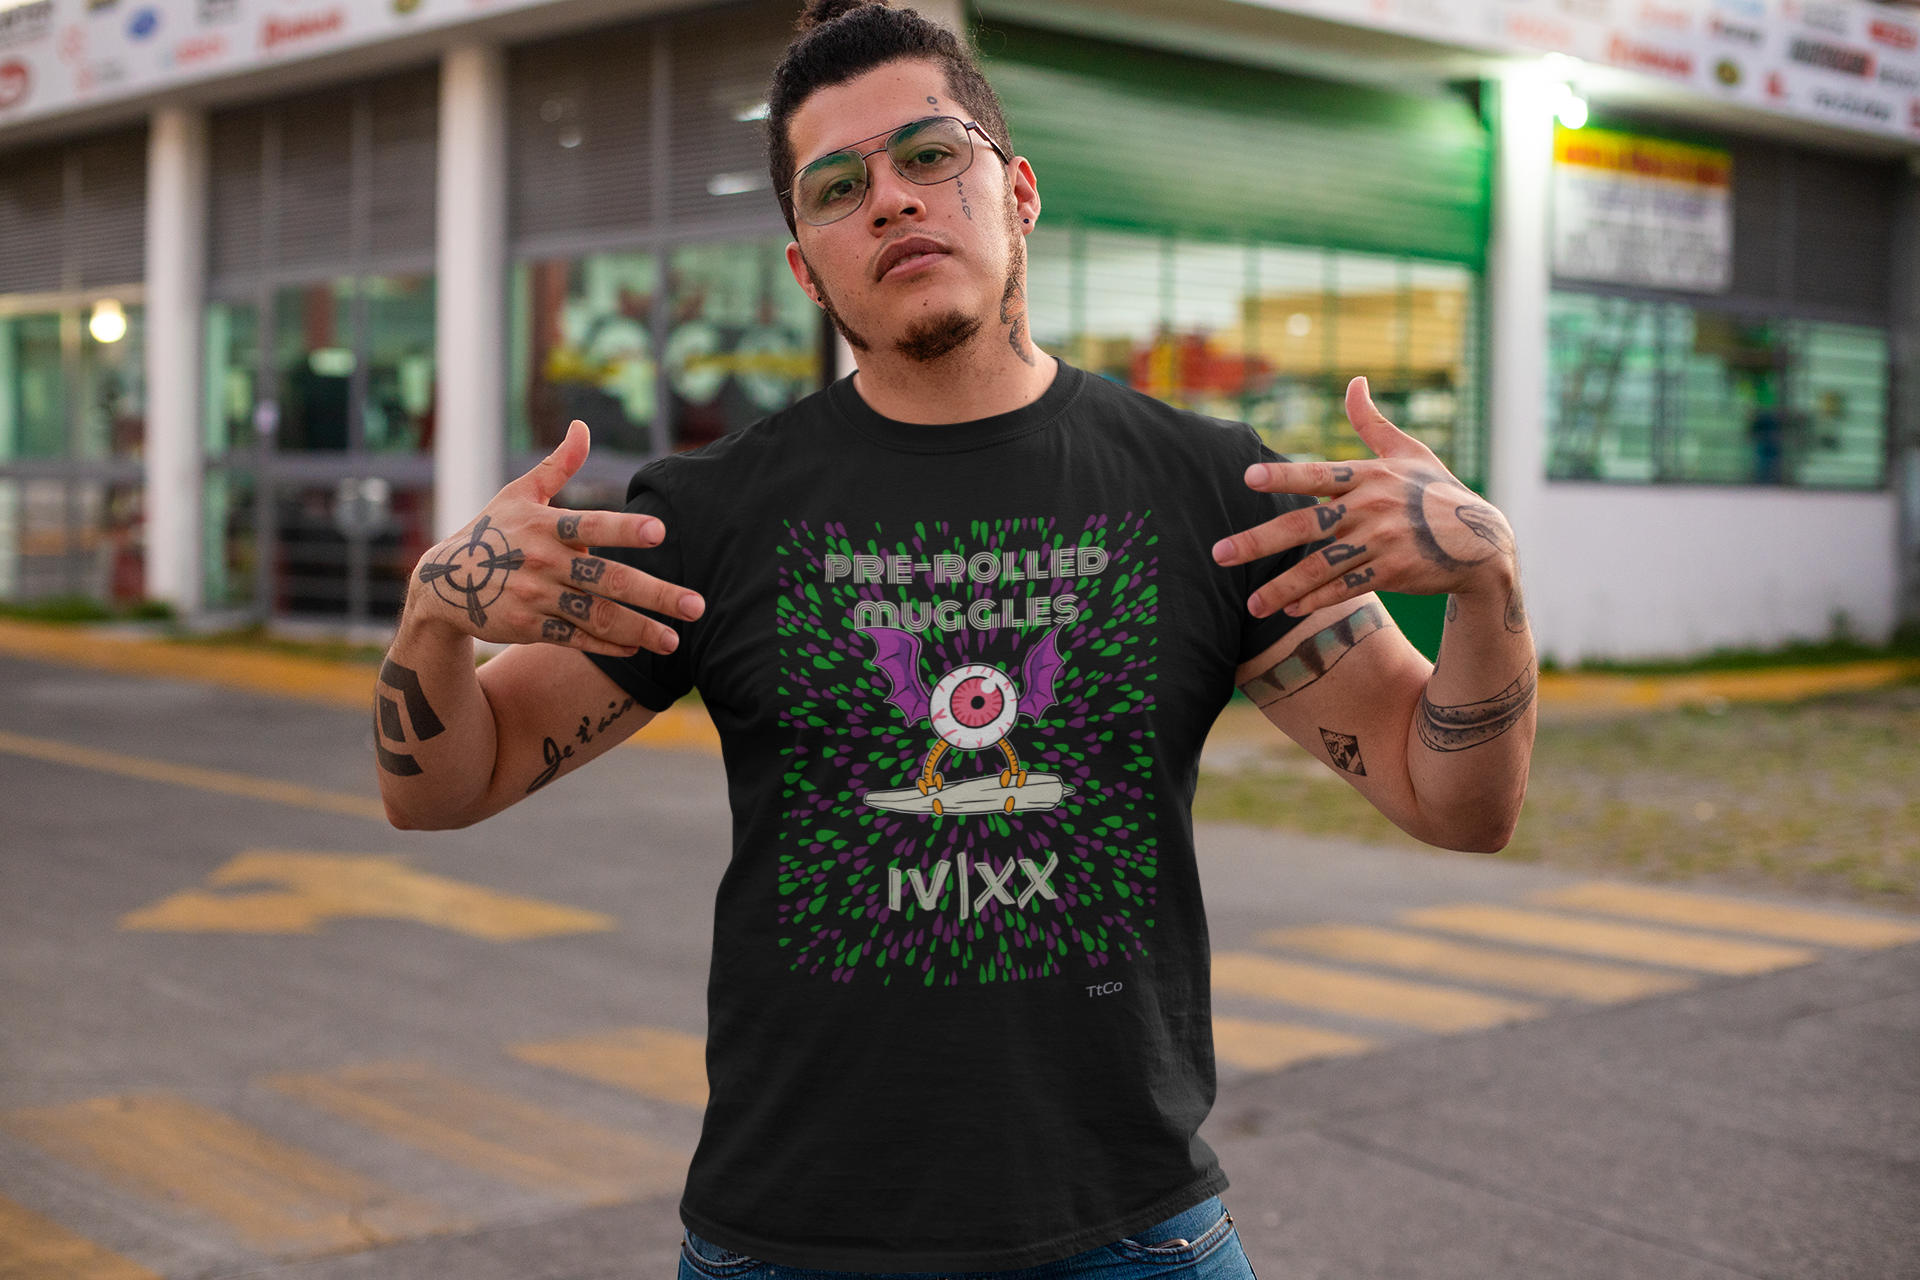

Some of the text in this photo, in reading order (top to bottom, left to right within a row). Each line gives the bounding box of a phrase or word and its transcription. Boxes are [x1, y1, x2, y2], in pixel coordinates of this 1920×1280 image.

[824, 546, 1109, 584] PRE-ROLLED
[854, 594, 1080, 632] MUGGLES
[1086, 981, 1123, 998] TtCo
